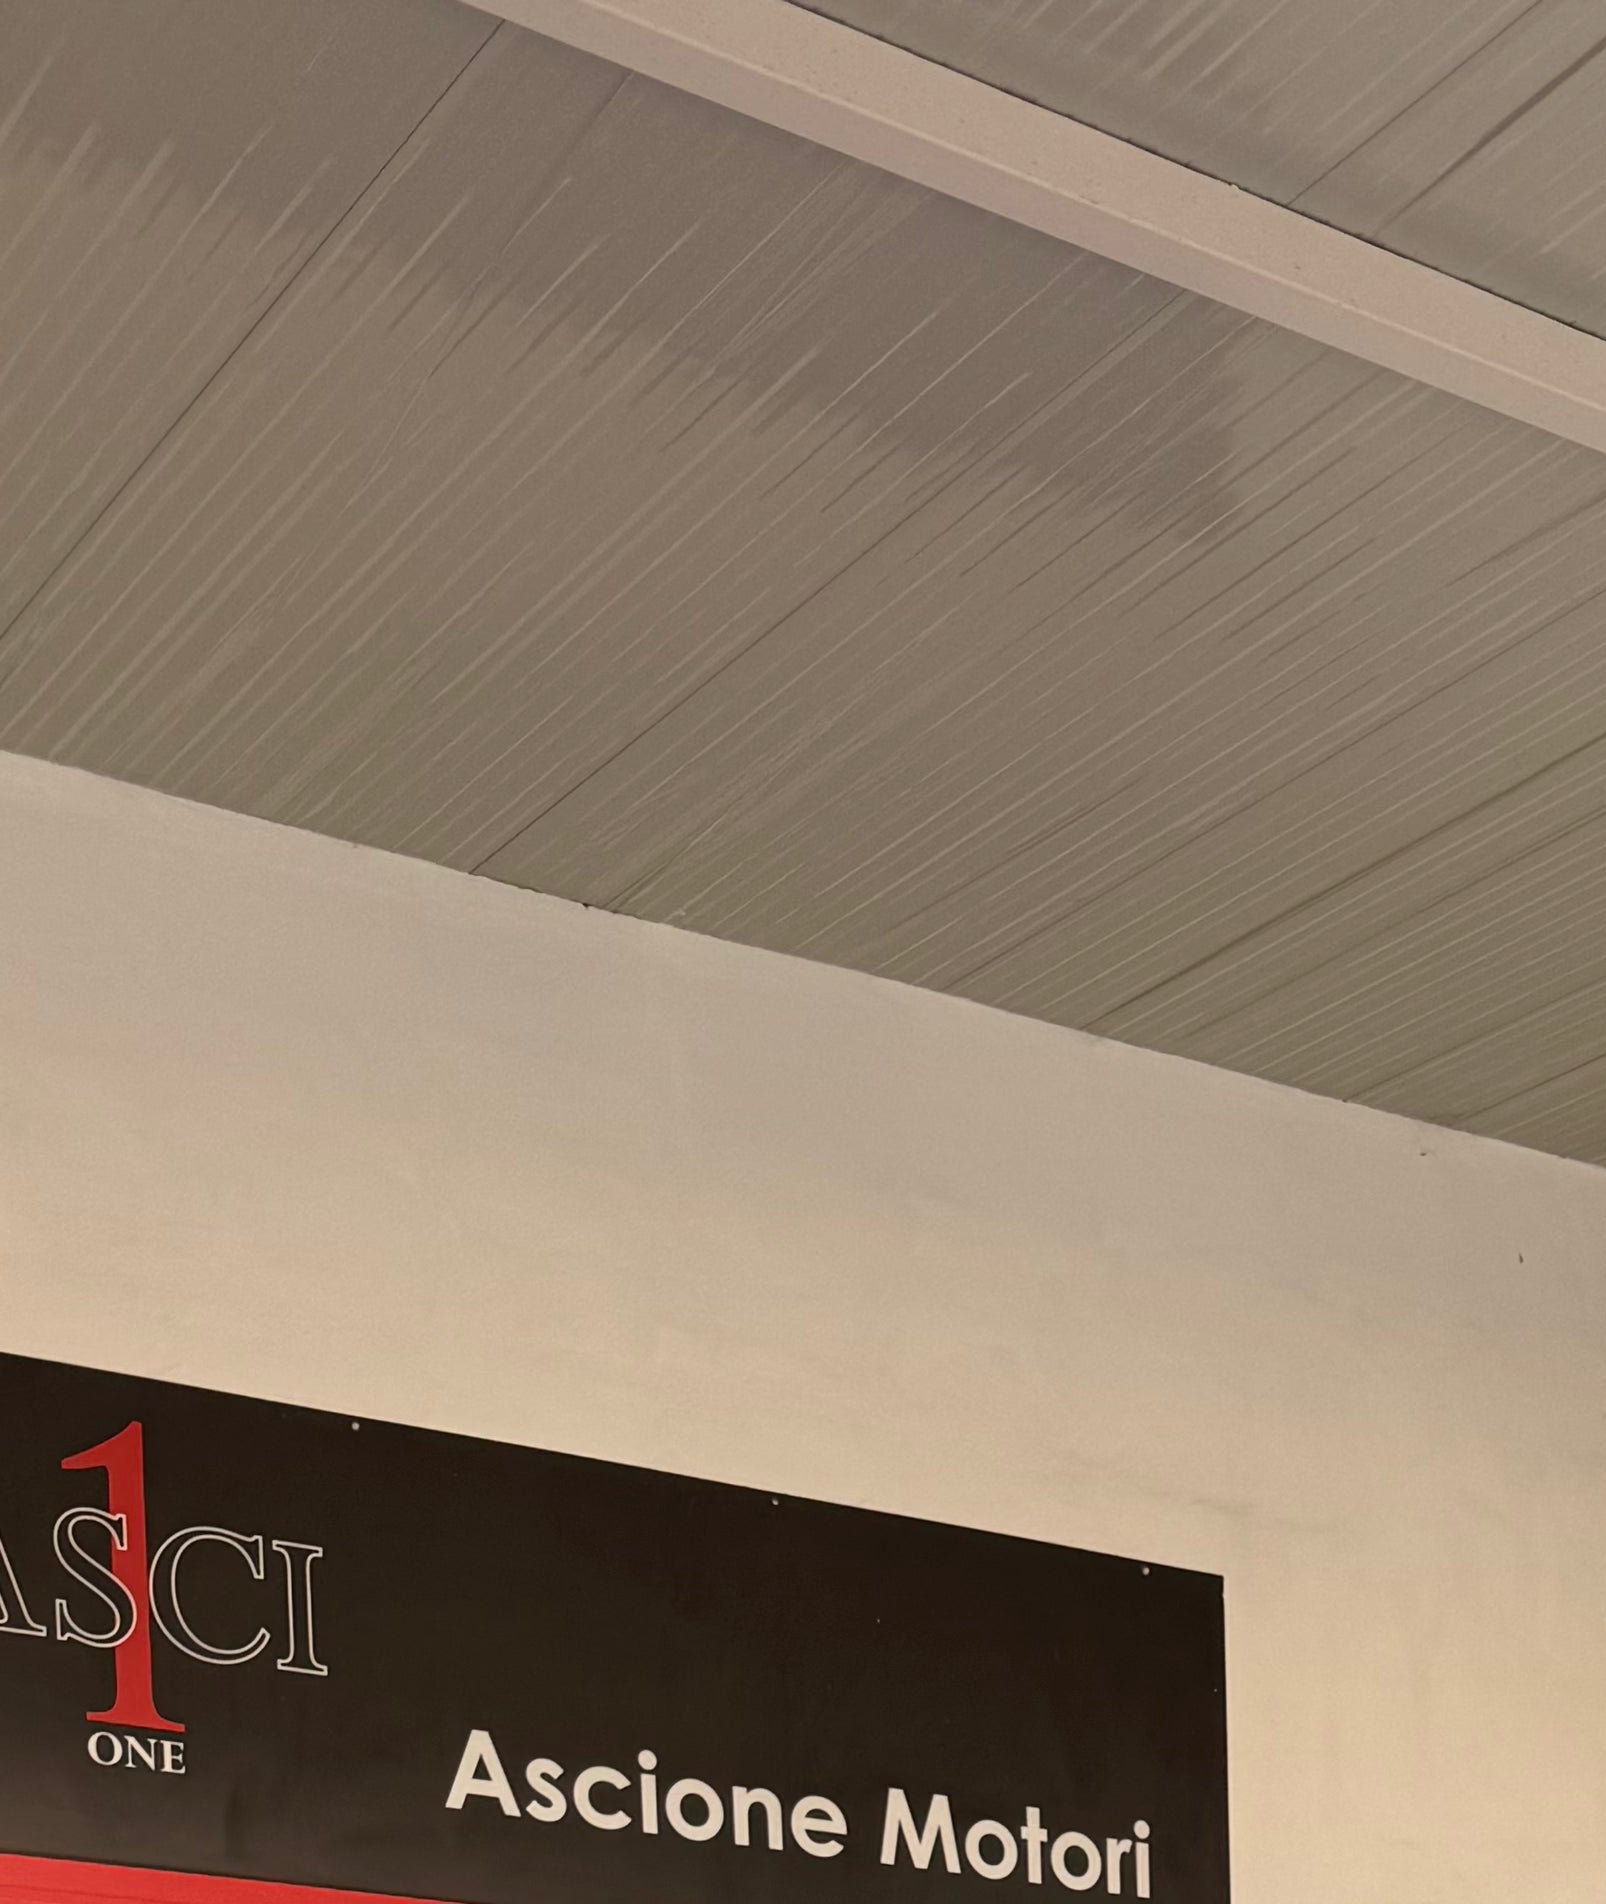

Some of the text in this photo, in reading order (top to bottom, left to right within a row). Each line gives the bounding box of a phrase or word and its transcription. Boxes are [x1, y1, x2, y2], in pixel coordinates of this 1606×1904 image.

[61, 1421, 185, 1732] 1
[87, 1731, 187, 1774] ONE
[445, 1729, 1150, 1899] Ascione Motori
